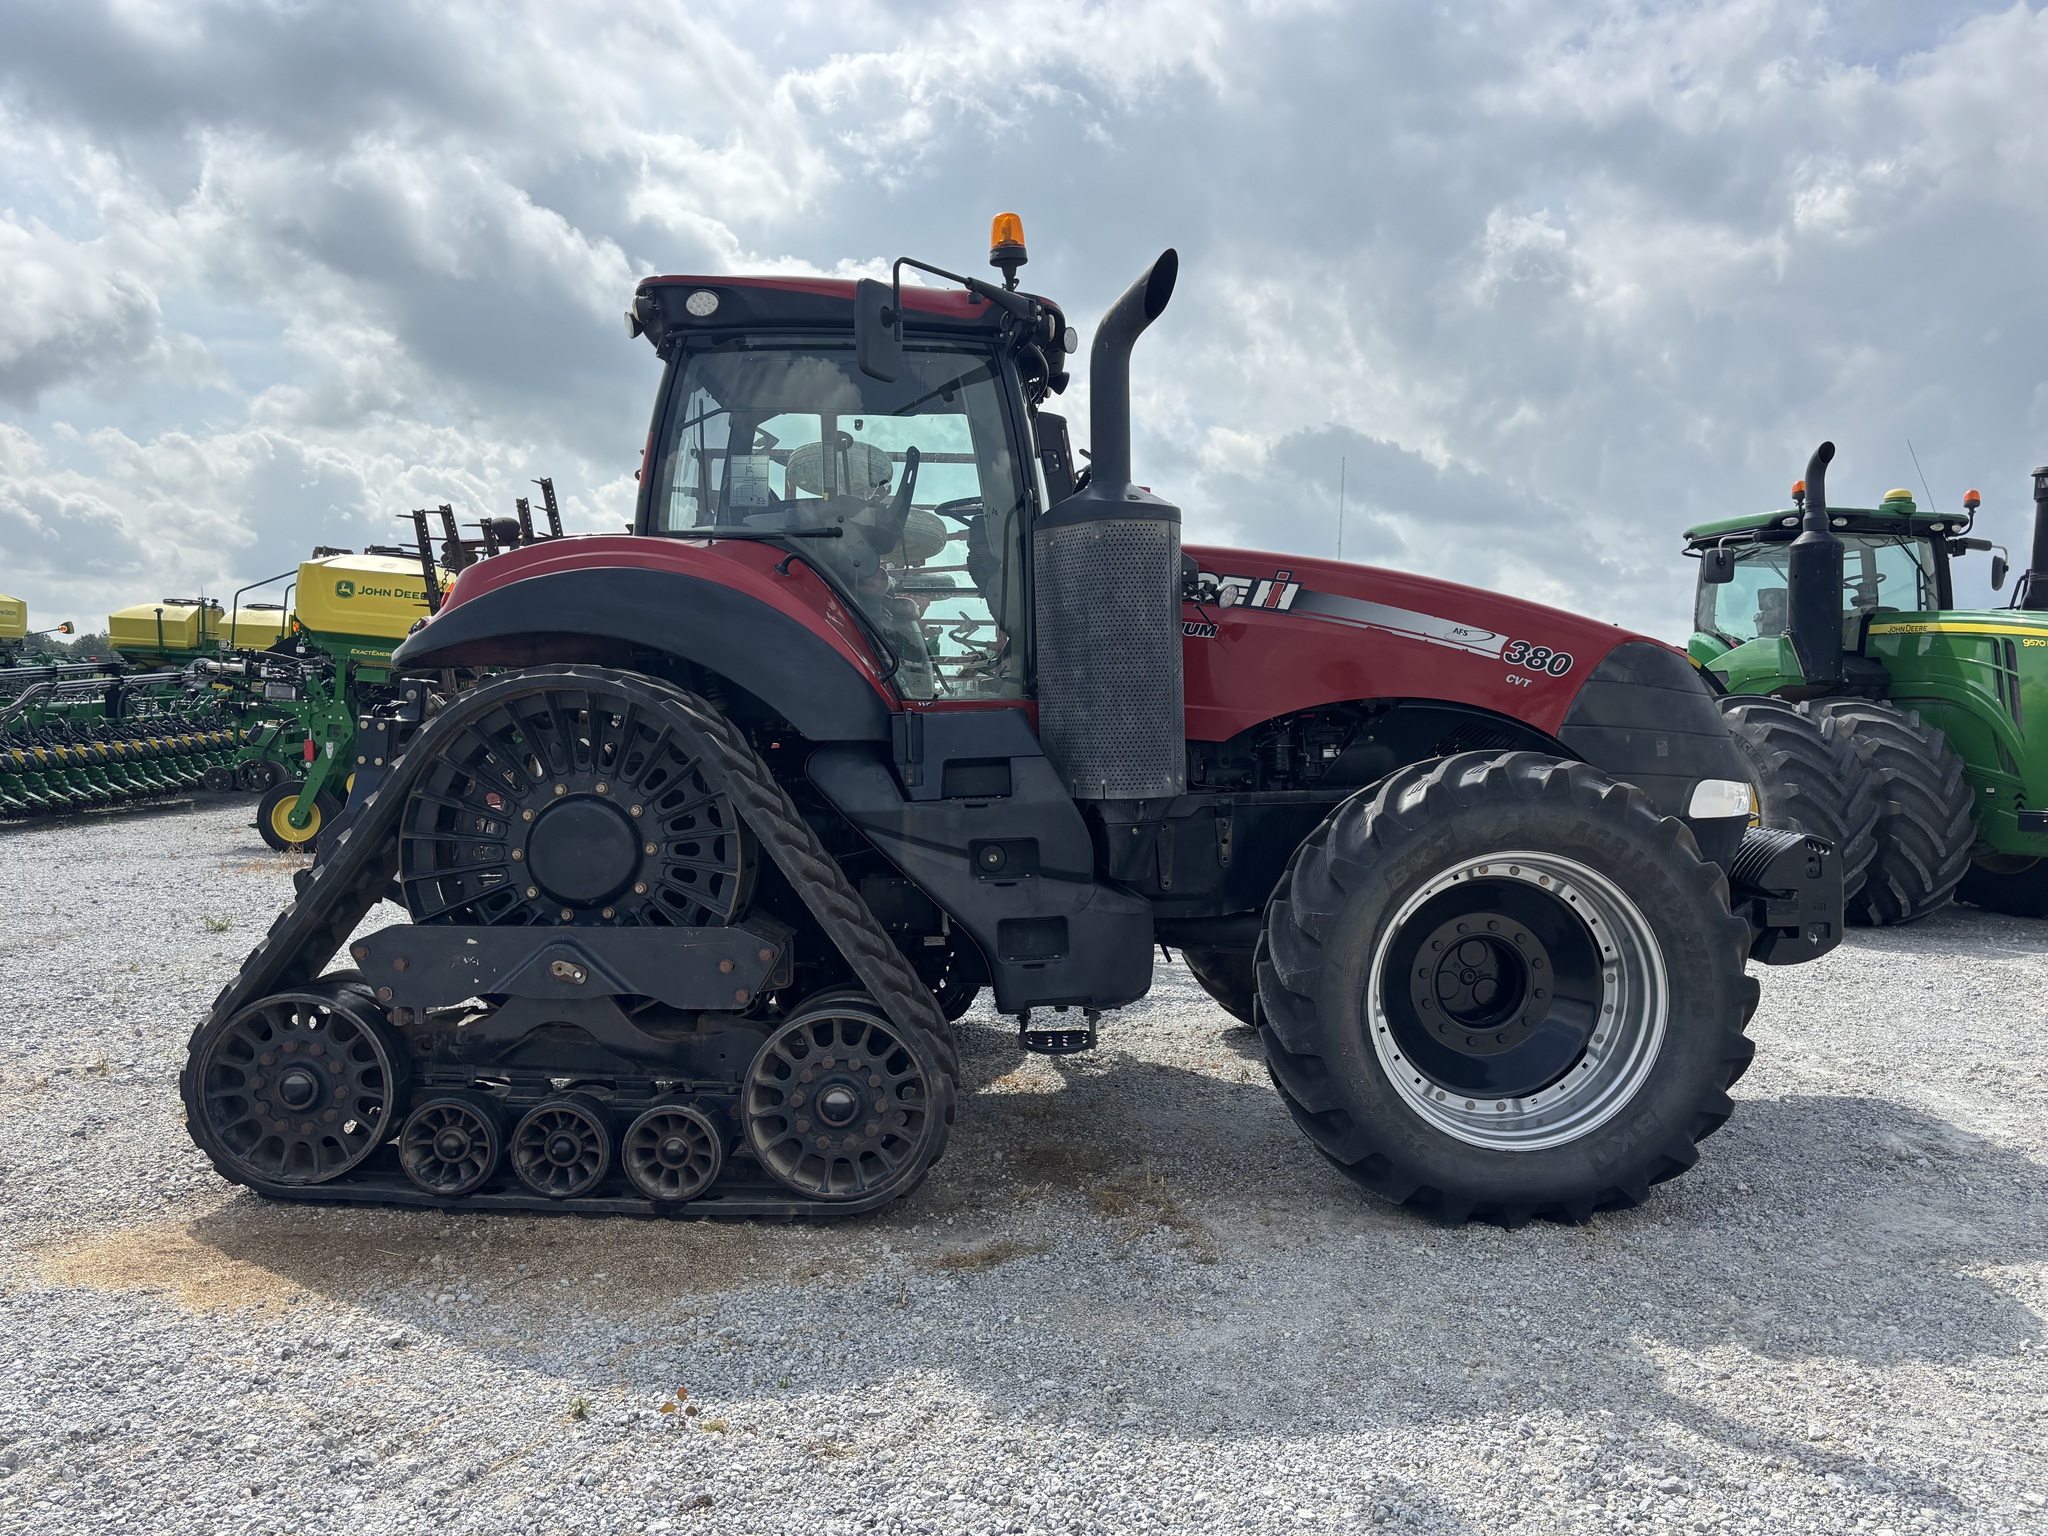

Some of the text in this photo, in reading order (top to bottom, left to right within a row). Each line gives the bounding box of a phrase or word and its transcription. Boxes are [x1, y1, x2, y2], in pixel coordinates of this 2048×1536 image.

[358, 586, 391, 597] JOHN
[1452, 627, 1469, 637] AFS
[1887, 624, 1928, 634] JOHN DEERE
[2022, 638, 2046, 647] 9570
[1504, 640, 1574, 677] 380
[1506, 674, 1532, 688] CVT
[1385, 834, 1453, 892] BKT
[1591, 1108, 1663, 1171] BKT
